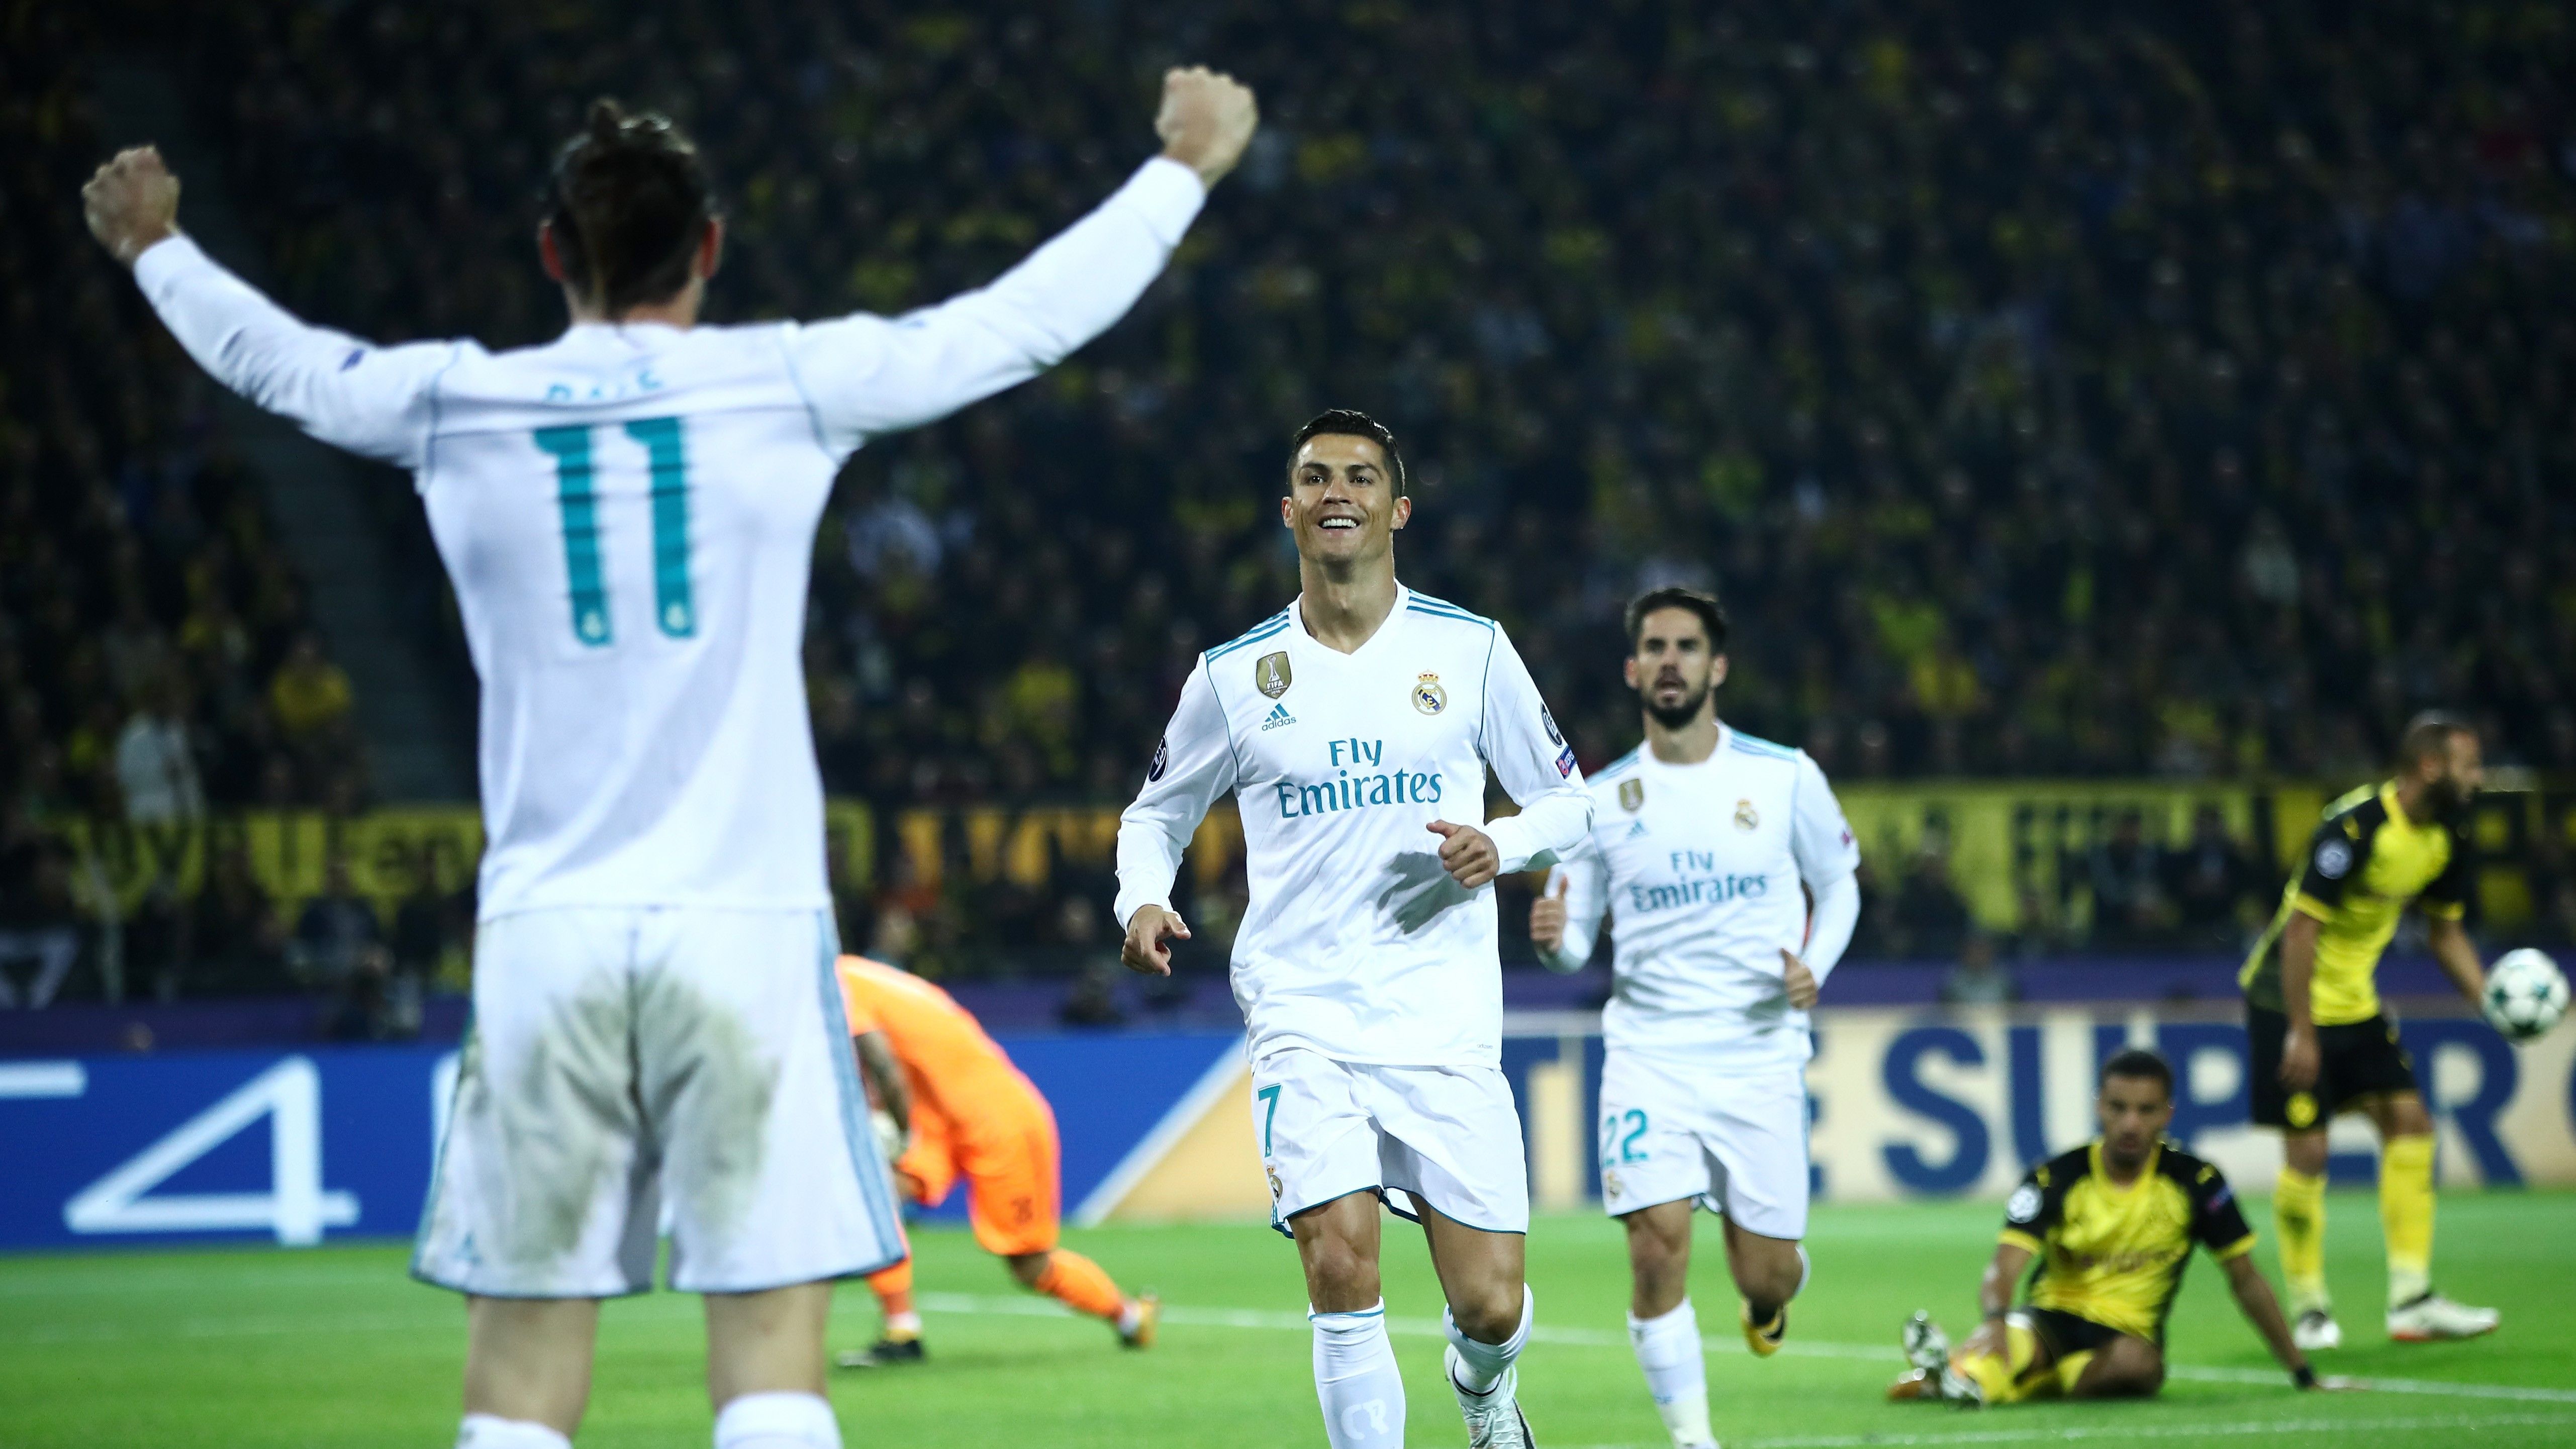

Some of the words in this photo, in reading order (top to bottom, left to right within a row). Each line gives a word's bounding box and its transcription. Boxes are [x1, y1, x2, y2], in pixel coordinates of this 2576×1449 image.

[532, 415, 698, 647] 11
[1266, 680, 1284, 690] FIFA
[1262, 717, 1296, 731] adidas
[1328, 738, 1382, 767] Fly
[1274, 767, 1442, 819] Emirates
[1669, 849, 1713, 874] Fly
[1628, 873, 1768, 914] Emirates
[1258, 1083, 1283, 1158] 7
[1881, 1019, 2525, 1194] SUPR
